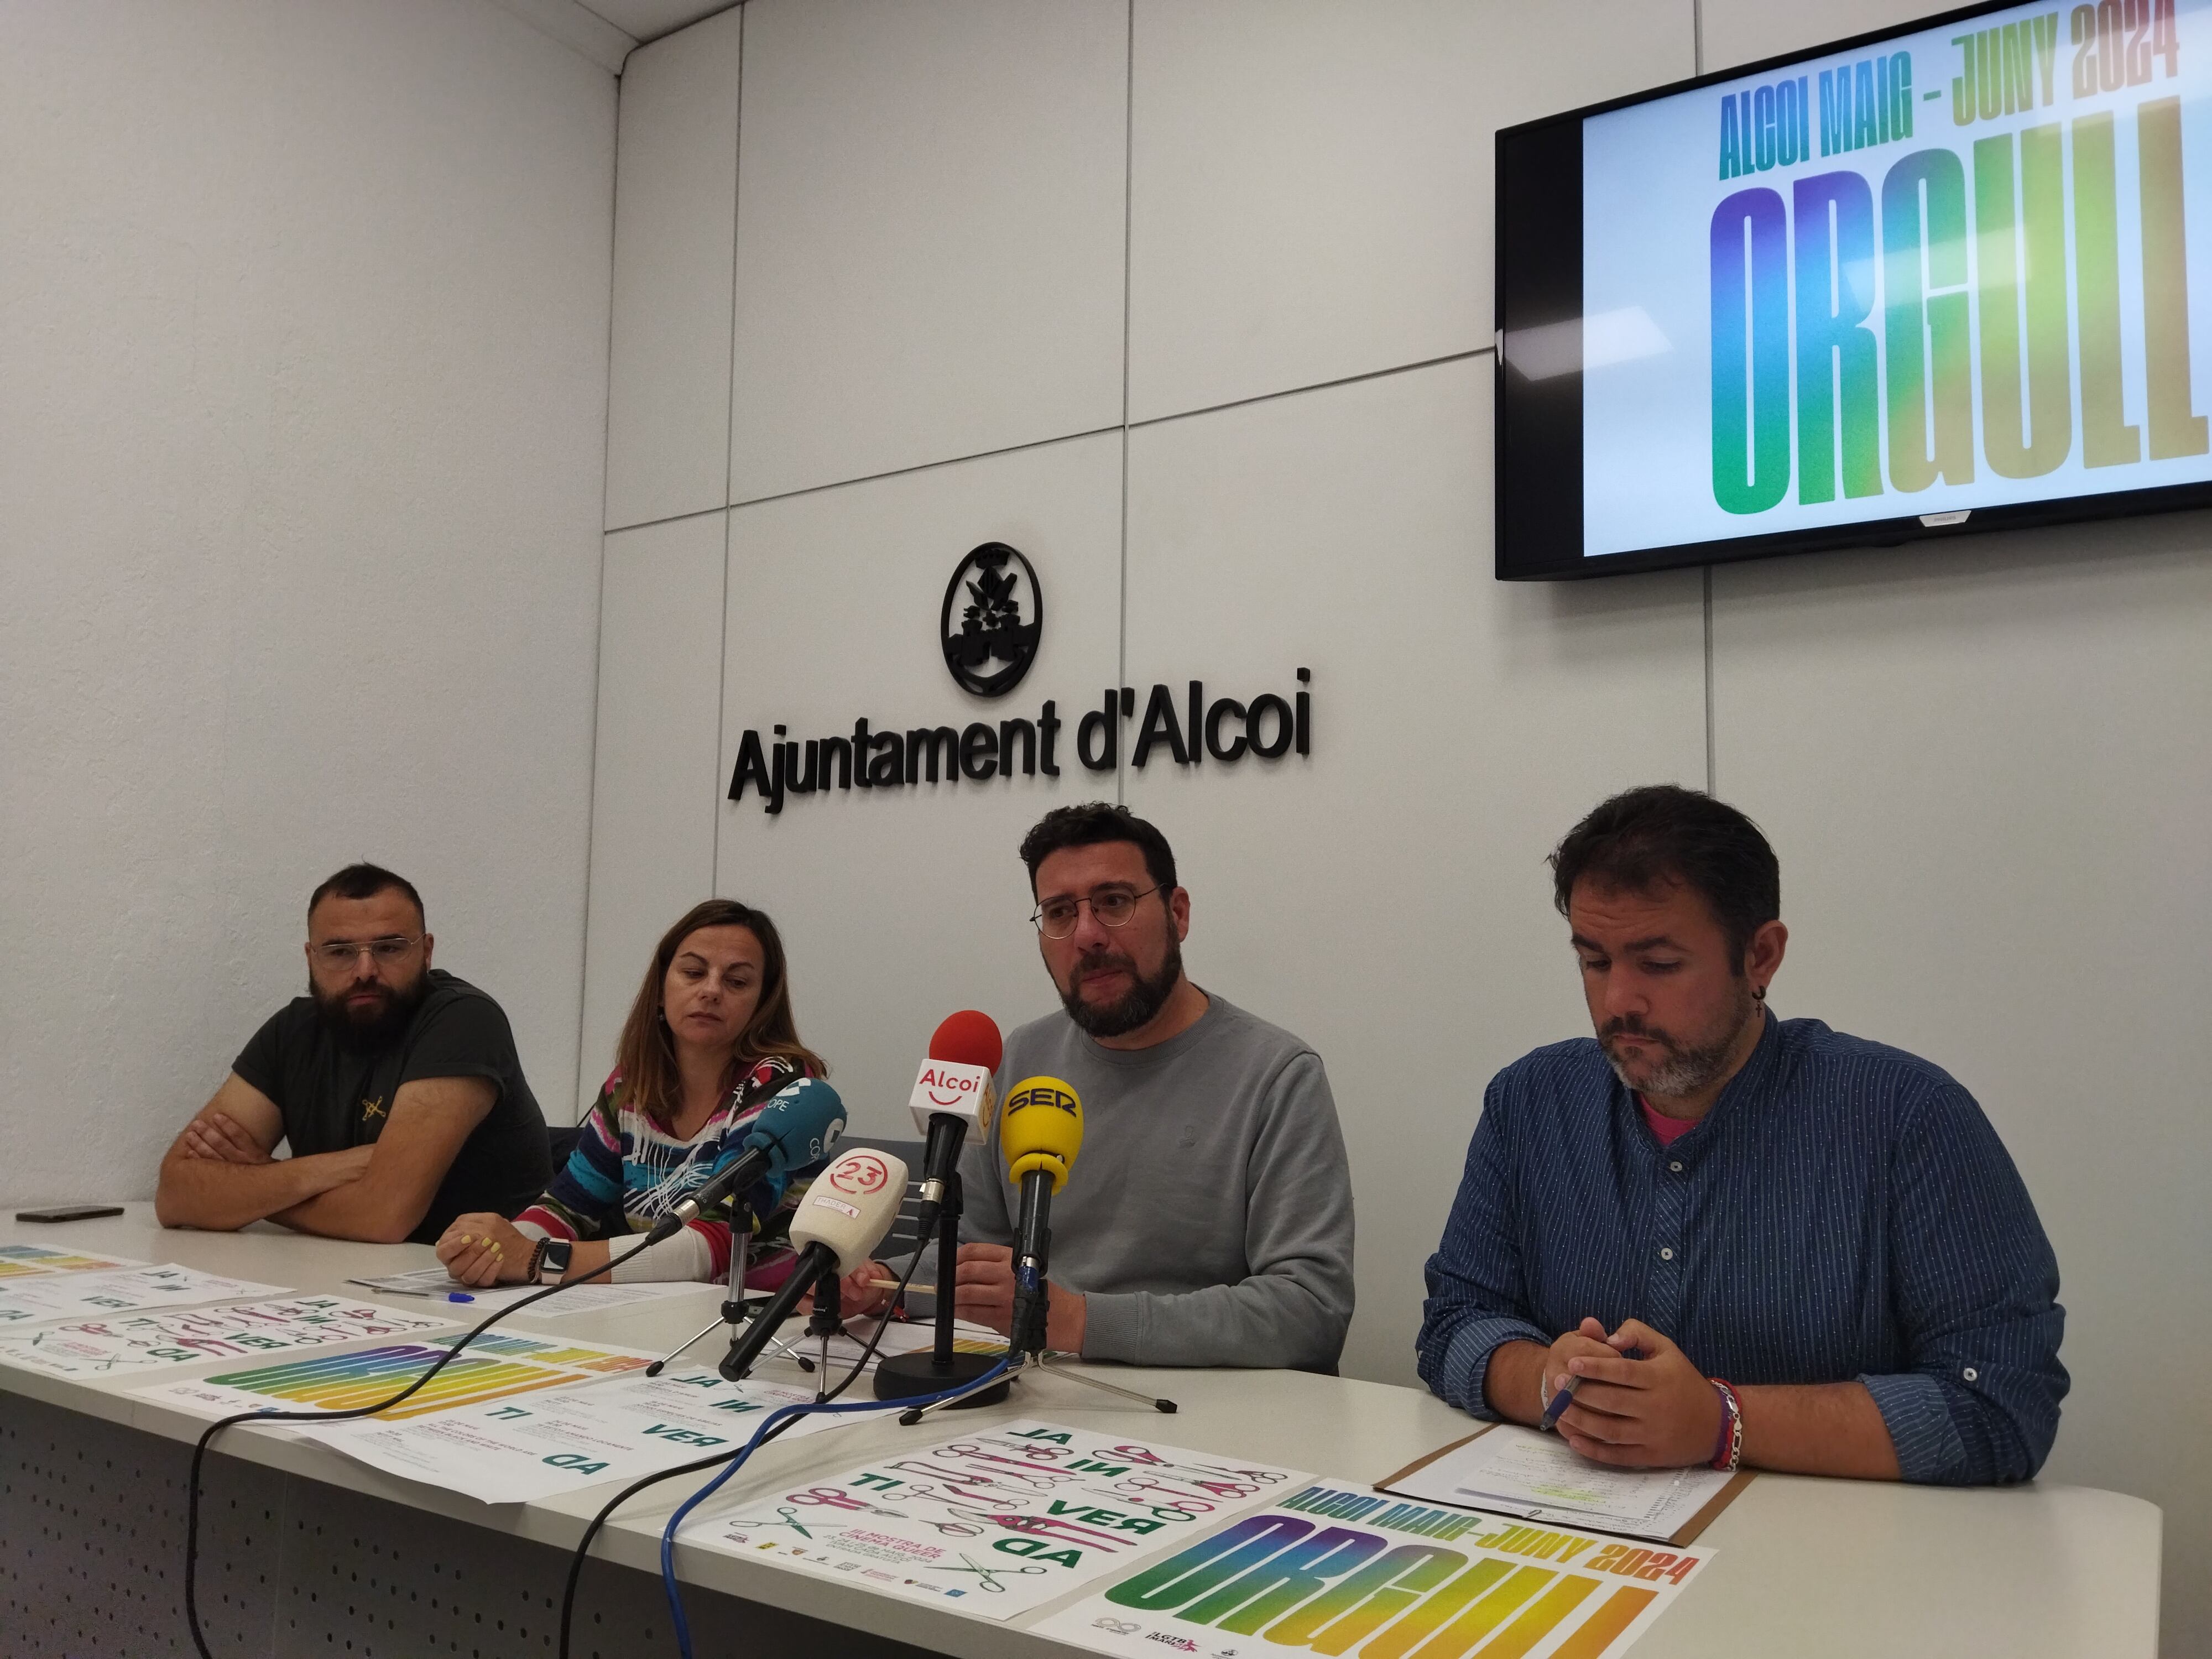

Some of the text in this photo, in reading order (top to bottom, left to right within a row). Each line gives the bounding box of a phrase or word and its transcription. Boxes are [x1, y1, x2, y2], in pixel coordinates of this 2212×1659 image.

[1719, 75, 1809, 180] ALCOI
[1819, 51, 1913, 156] MAIG
[1951, 12, 2058, 126] JUNY
[2070, 0, 2179, 98] 2024
[1710, 96, 2209, 515] ORGULL
[728, 667, 1310, 813] Ajuntament d'Alcoi
[919, 1069, 980, 1092] Alcoi
[764, 1099, 790, 1112] OPE
[1008, 1088, 1076, 1117] SER
[836, 1162, 883, 1186] 23
[839, 1532, 941, 1559] CINEMA QUEER
[867, 1532, 922, 1549] MOSTRA
[1276, 1486, 1390, 1521] ALCOI
[1381, 1503, 1483, 1542] MAIG
[1474, 1523, 1599, 1564] JUNY
[1584, 1544, 1700, 1585] 2024
